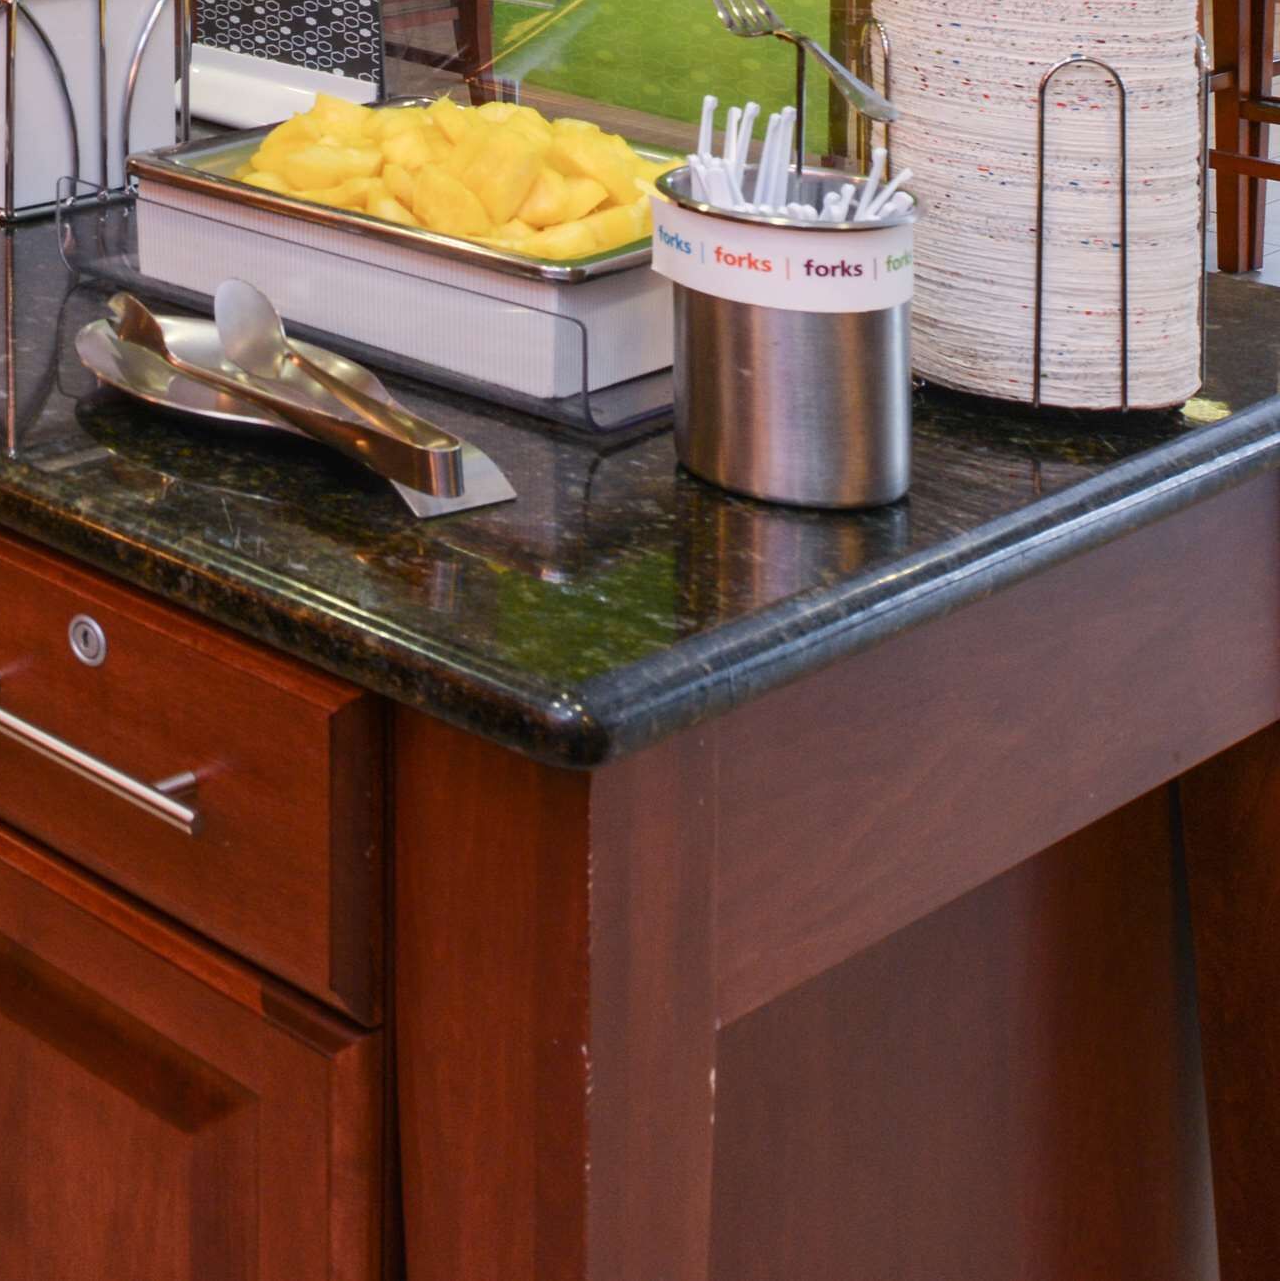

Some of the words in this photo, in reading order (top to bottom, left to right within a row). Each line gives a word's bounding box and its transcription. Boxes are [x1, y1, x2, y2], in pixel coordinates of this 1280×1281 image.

[658, 224, 692, 255] forks
[714, 245, 773, 273] forks
[804, 257, 864, 278] forks
